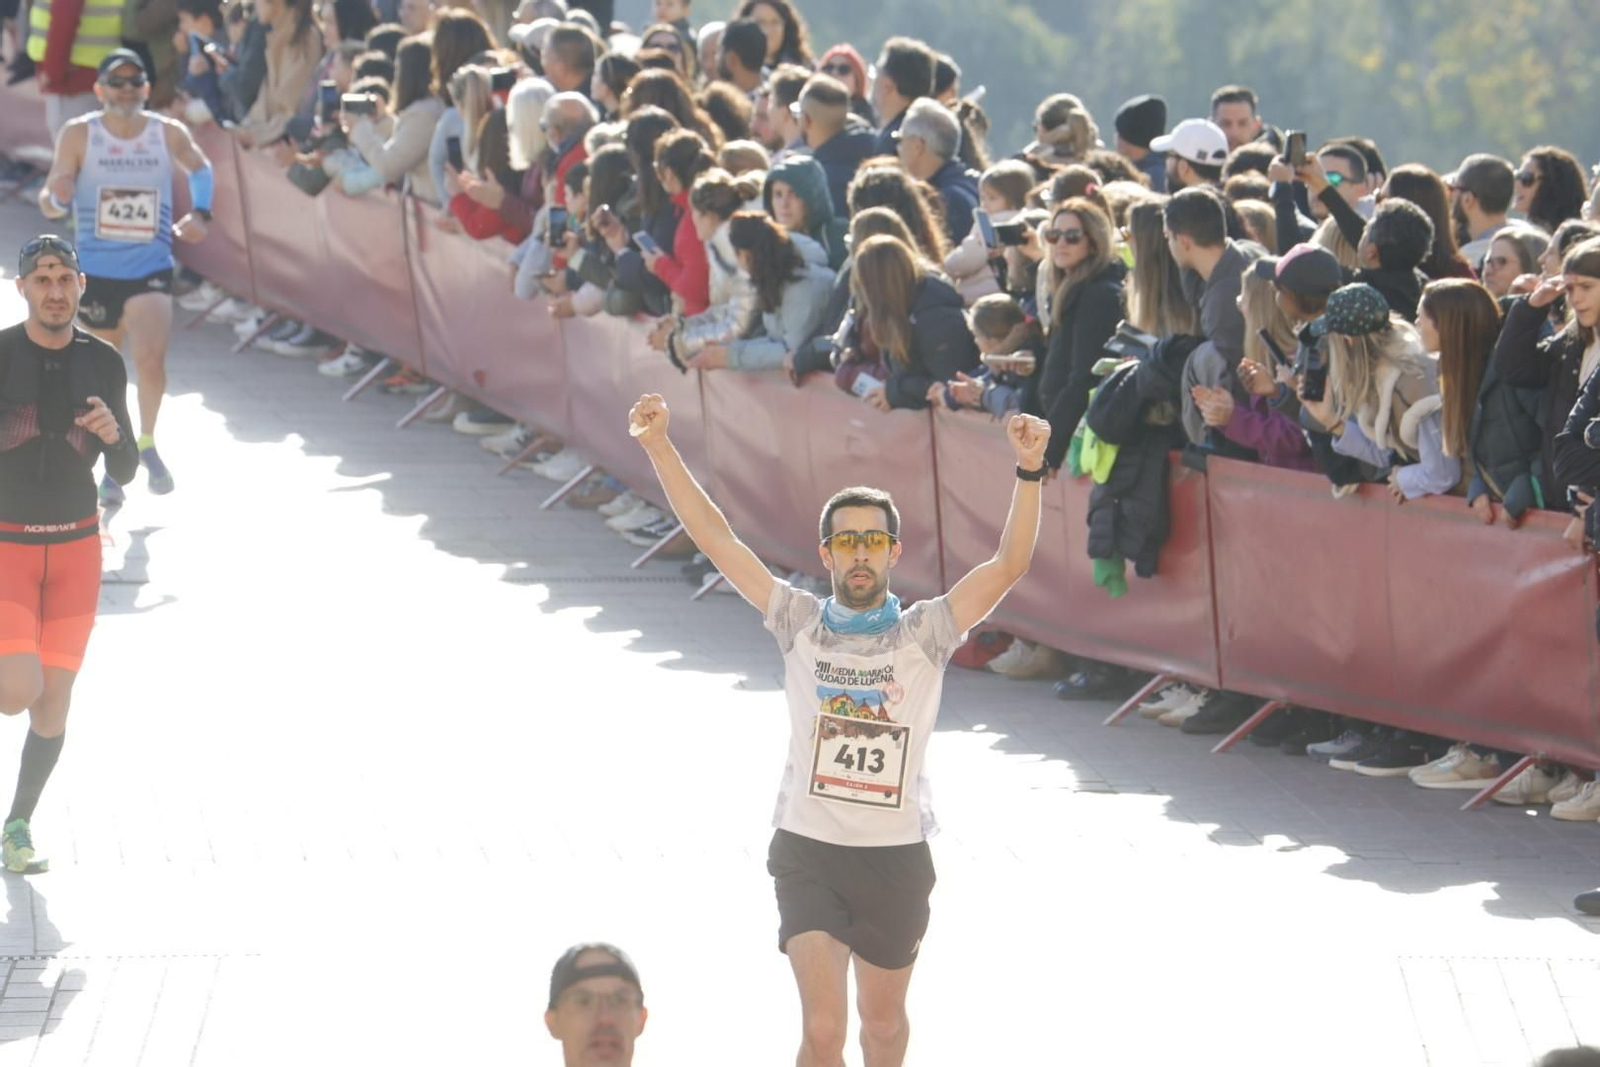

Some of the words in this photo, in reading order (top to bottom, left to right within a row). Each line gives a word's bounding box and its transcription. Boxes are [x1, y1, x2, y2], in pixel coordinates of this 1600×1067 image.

[108, 202, 148, 220] 424
[814, 656, 831, 674] VIII
[831, 666, 856, 677] MEDIA
[814, 669, 847, 685] CIUDAD
[848, 677, 860, 686] DE
[833, 743, 886, 774] 413
